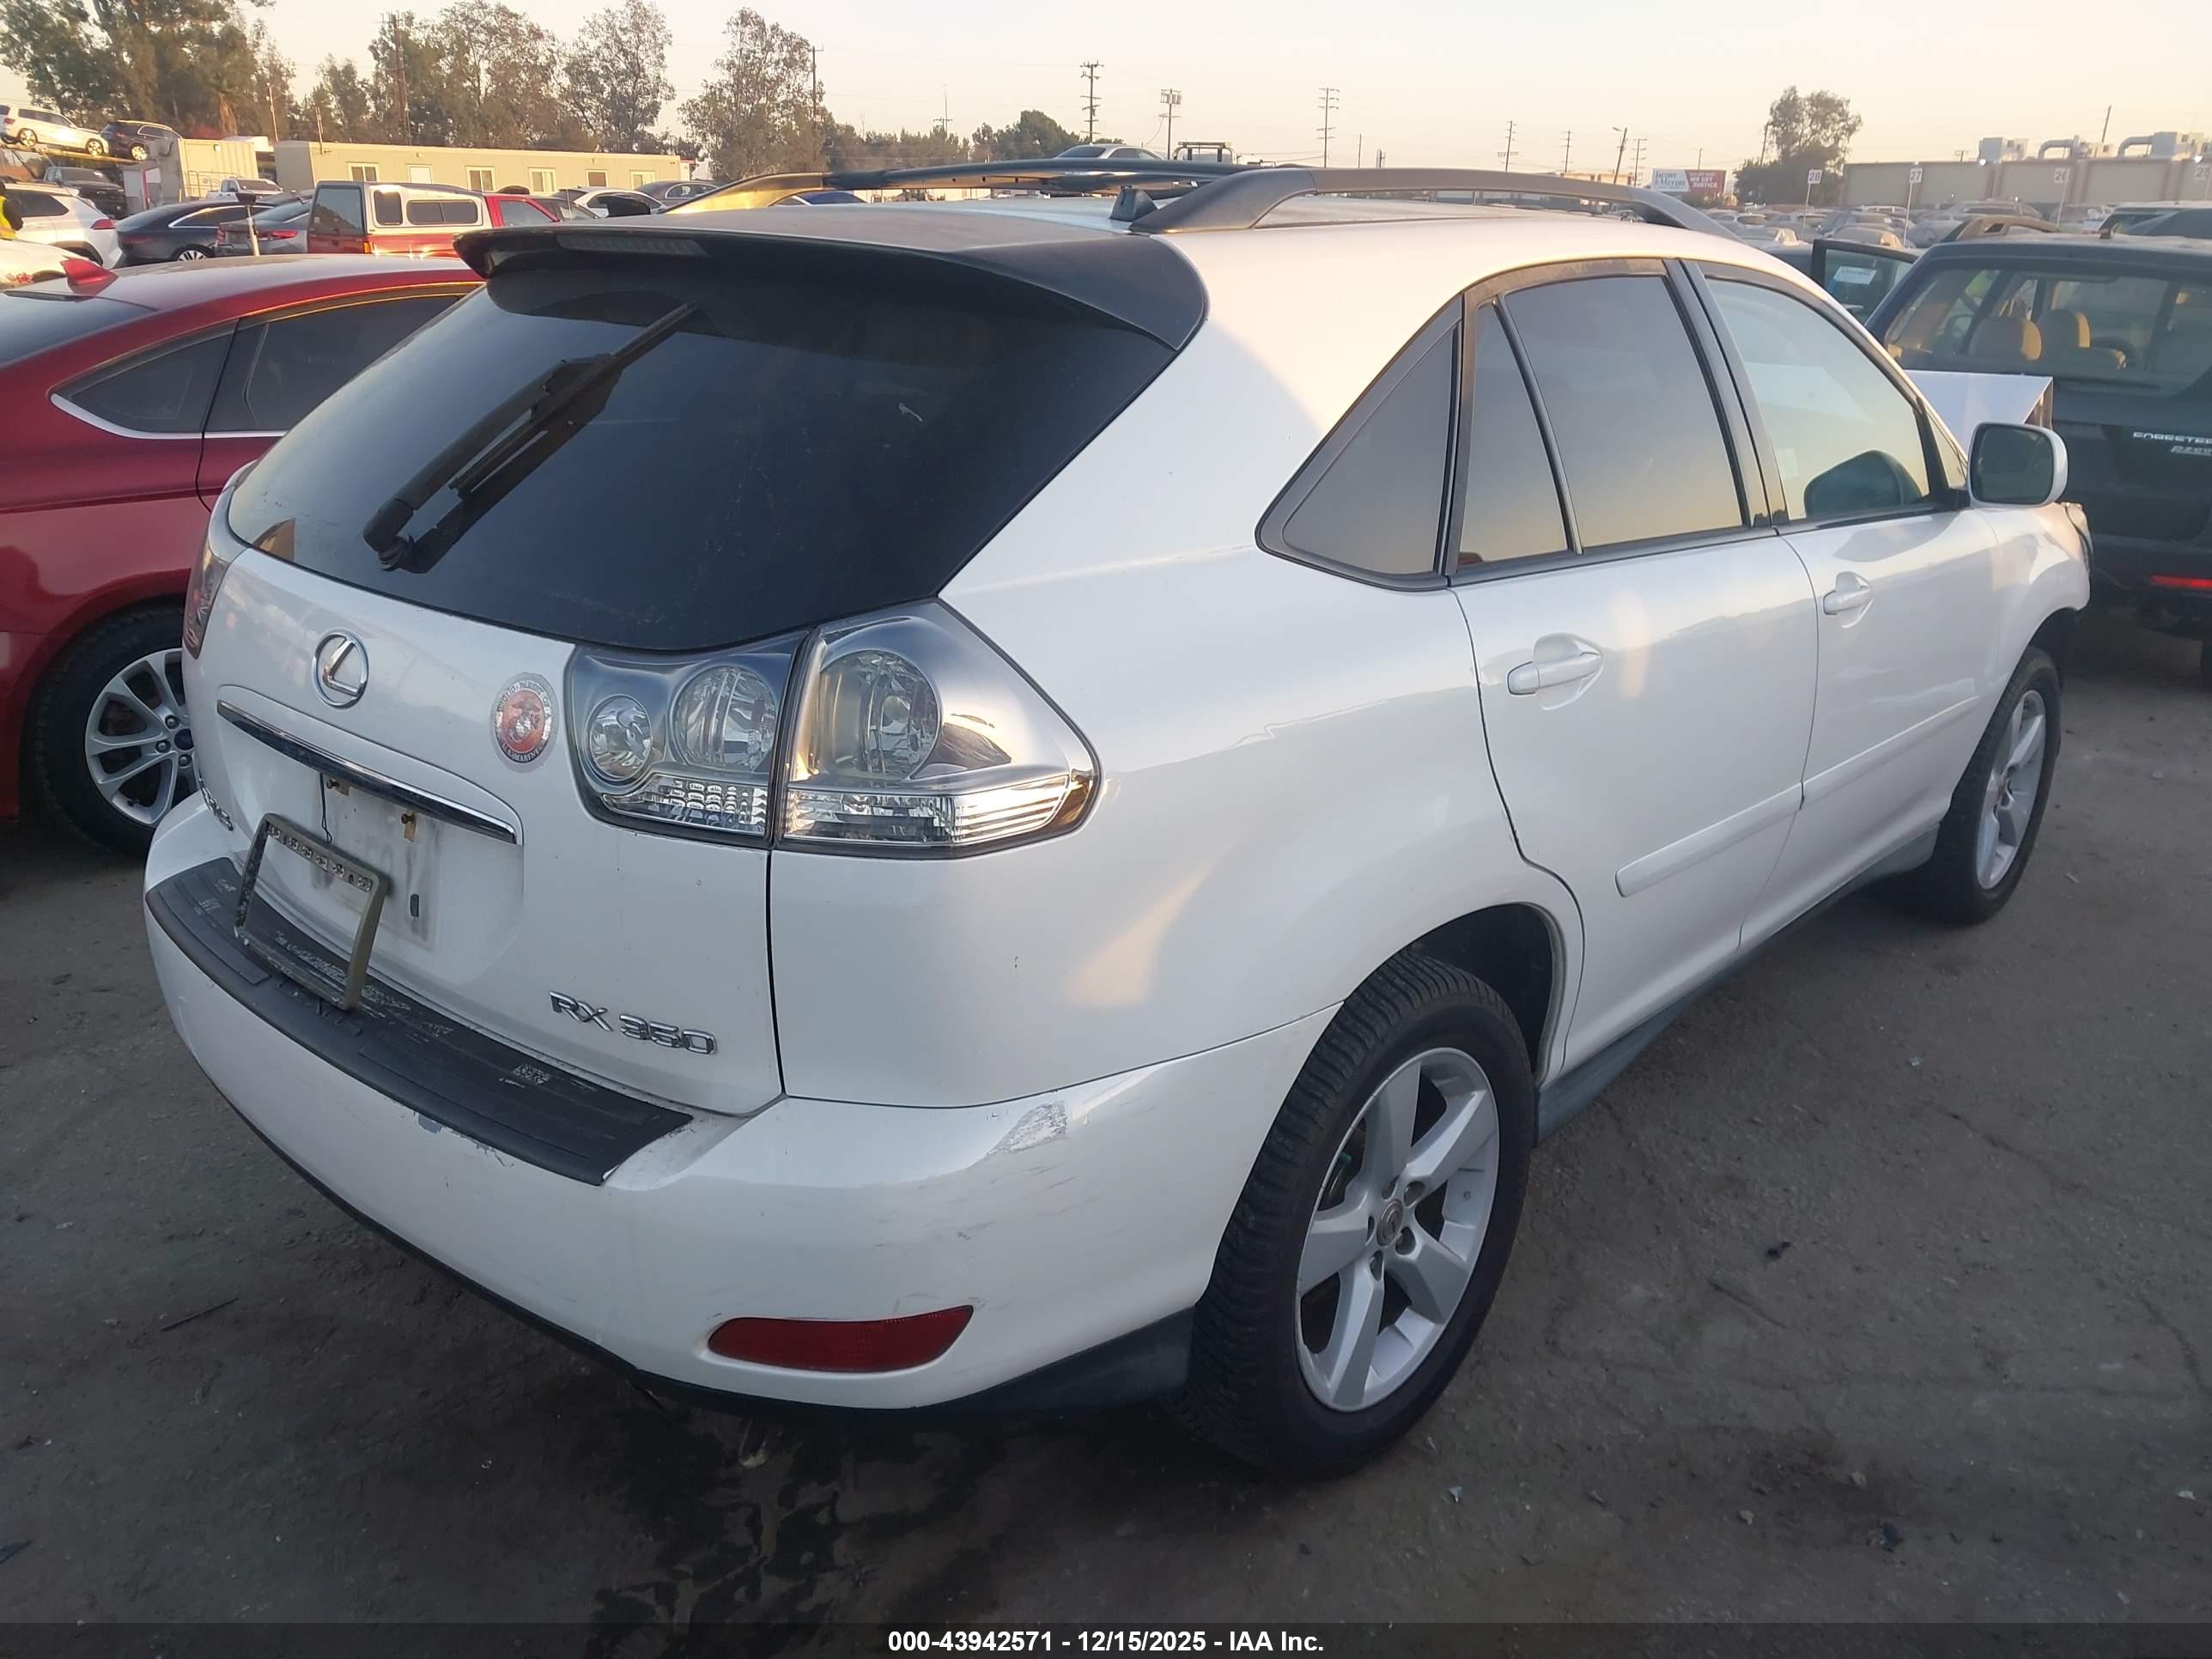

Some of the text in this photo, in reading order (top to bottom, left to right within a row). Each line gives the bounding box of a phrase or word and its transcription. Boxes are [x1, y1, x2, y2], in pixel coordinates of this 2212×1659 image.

[1911, 171, 1921, 180] 27
[549, 991, 717, 1055] RX 350
